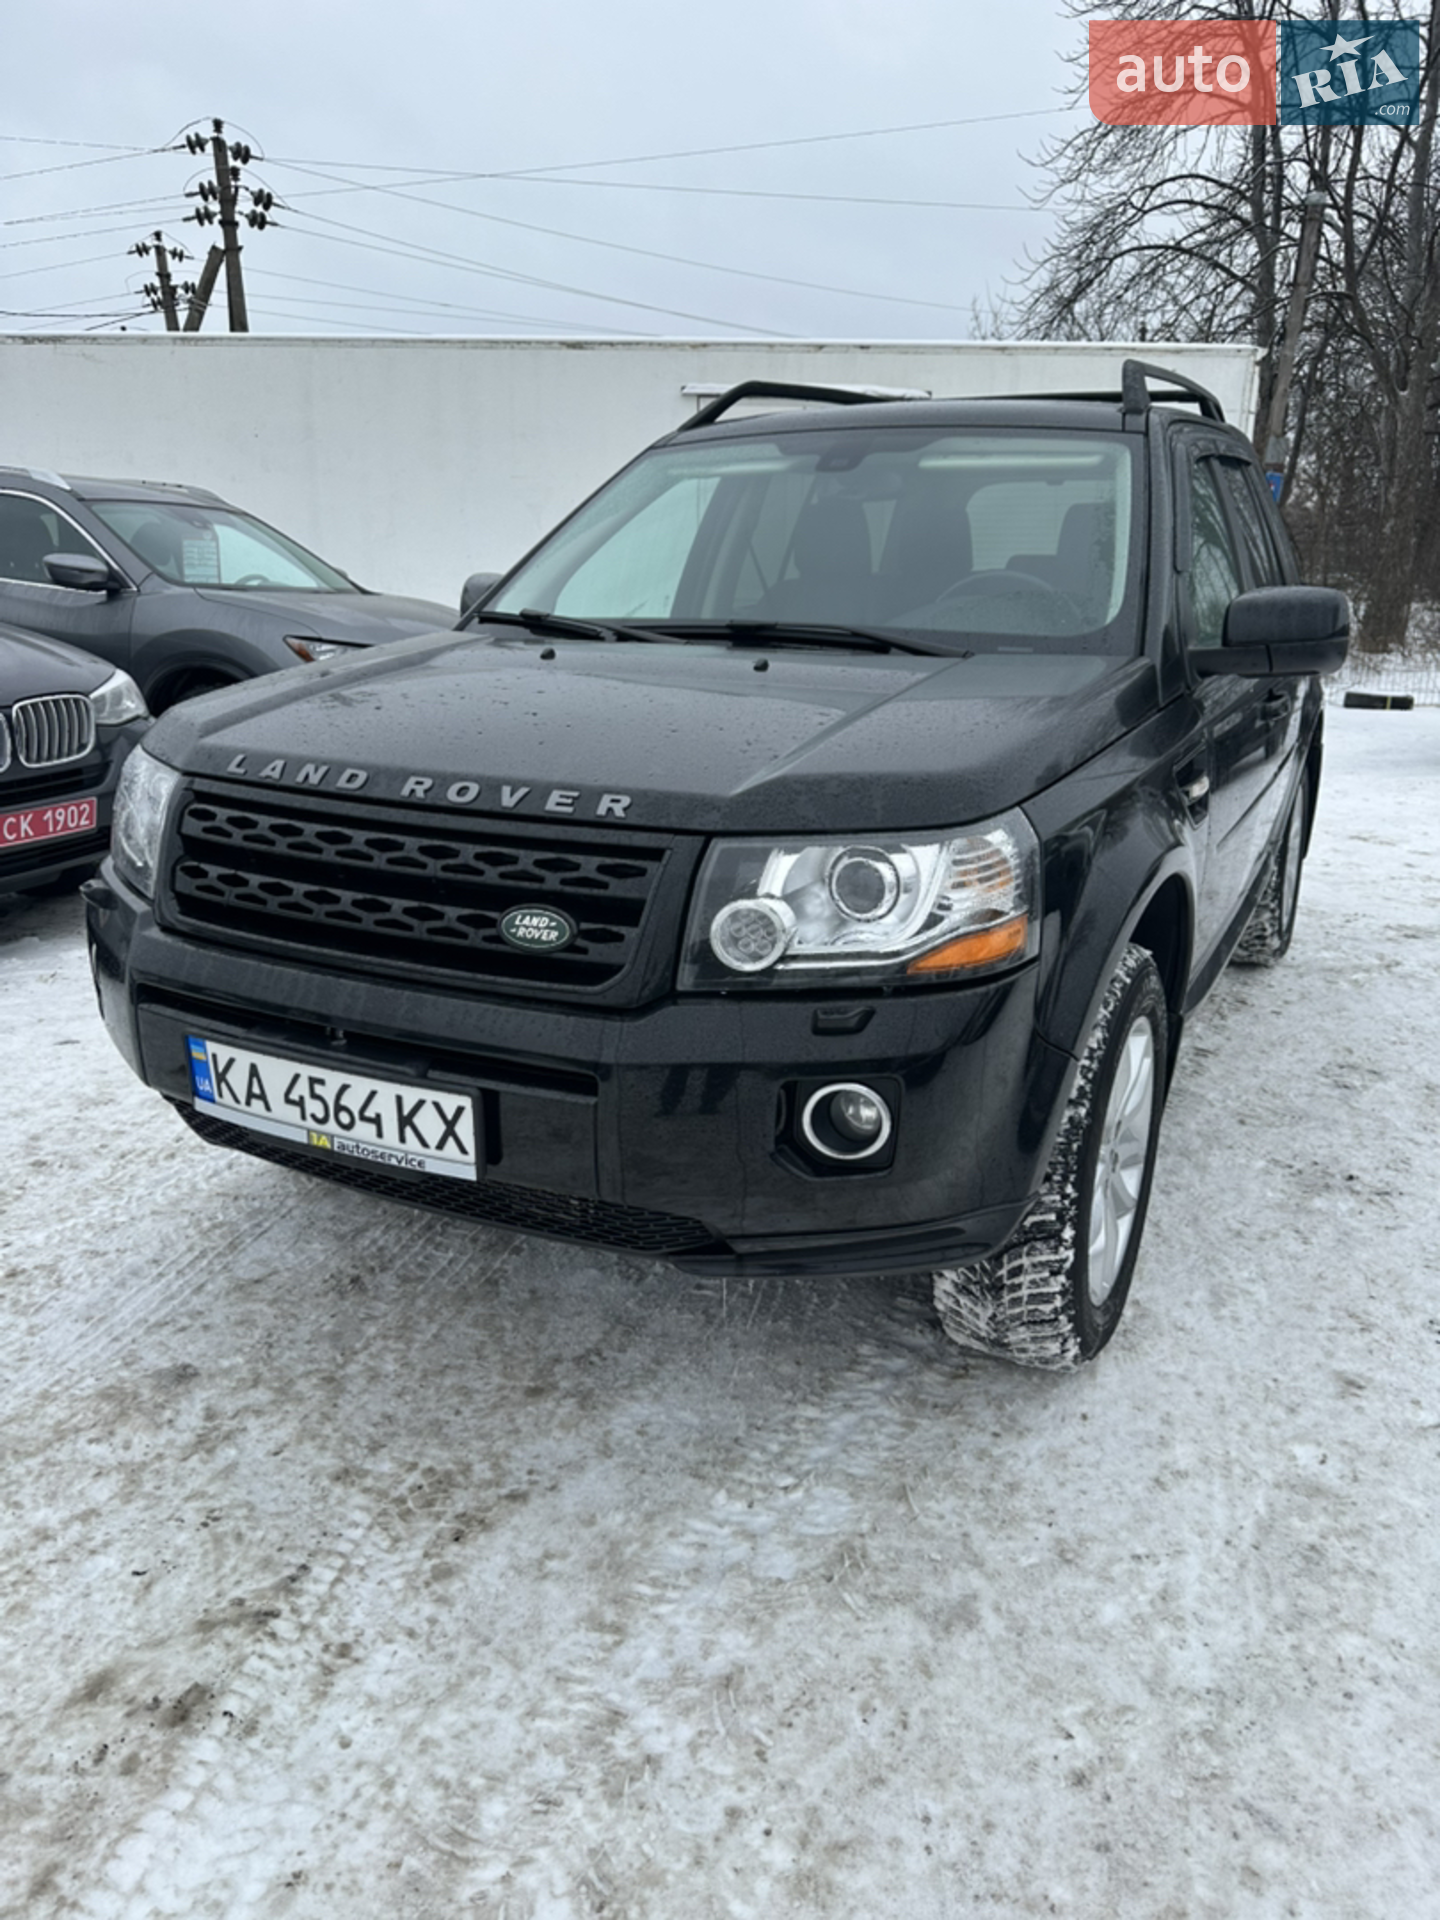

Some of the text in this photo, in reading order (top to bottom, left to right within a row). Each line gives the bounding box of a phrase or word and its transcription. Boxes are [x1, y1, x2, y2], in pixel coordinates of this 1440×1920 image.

[226, 754, 633, 819] LAND ROVER
[3, 803, 91, 840] CK 1902
[211, 1052, 470, 1156] KA 4564 KX
[336, 1140, 426, 1169] autoservice
